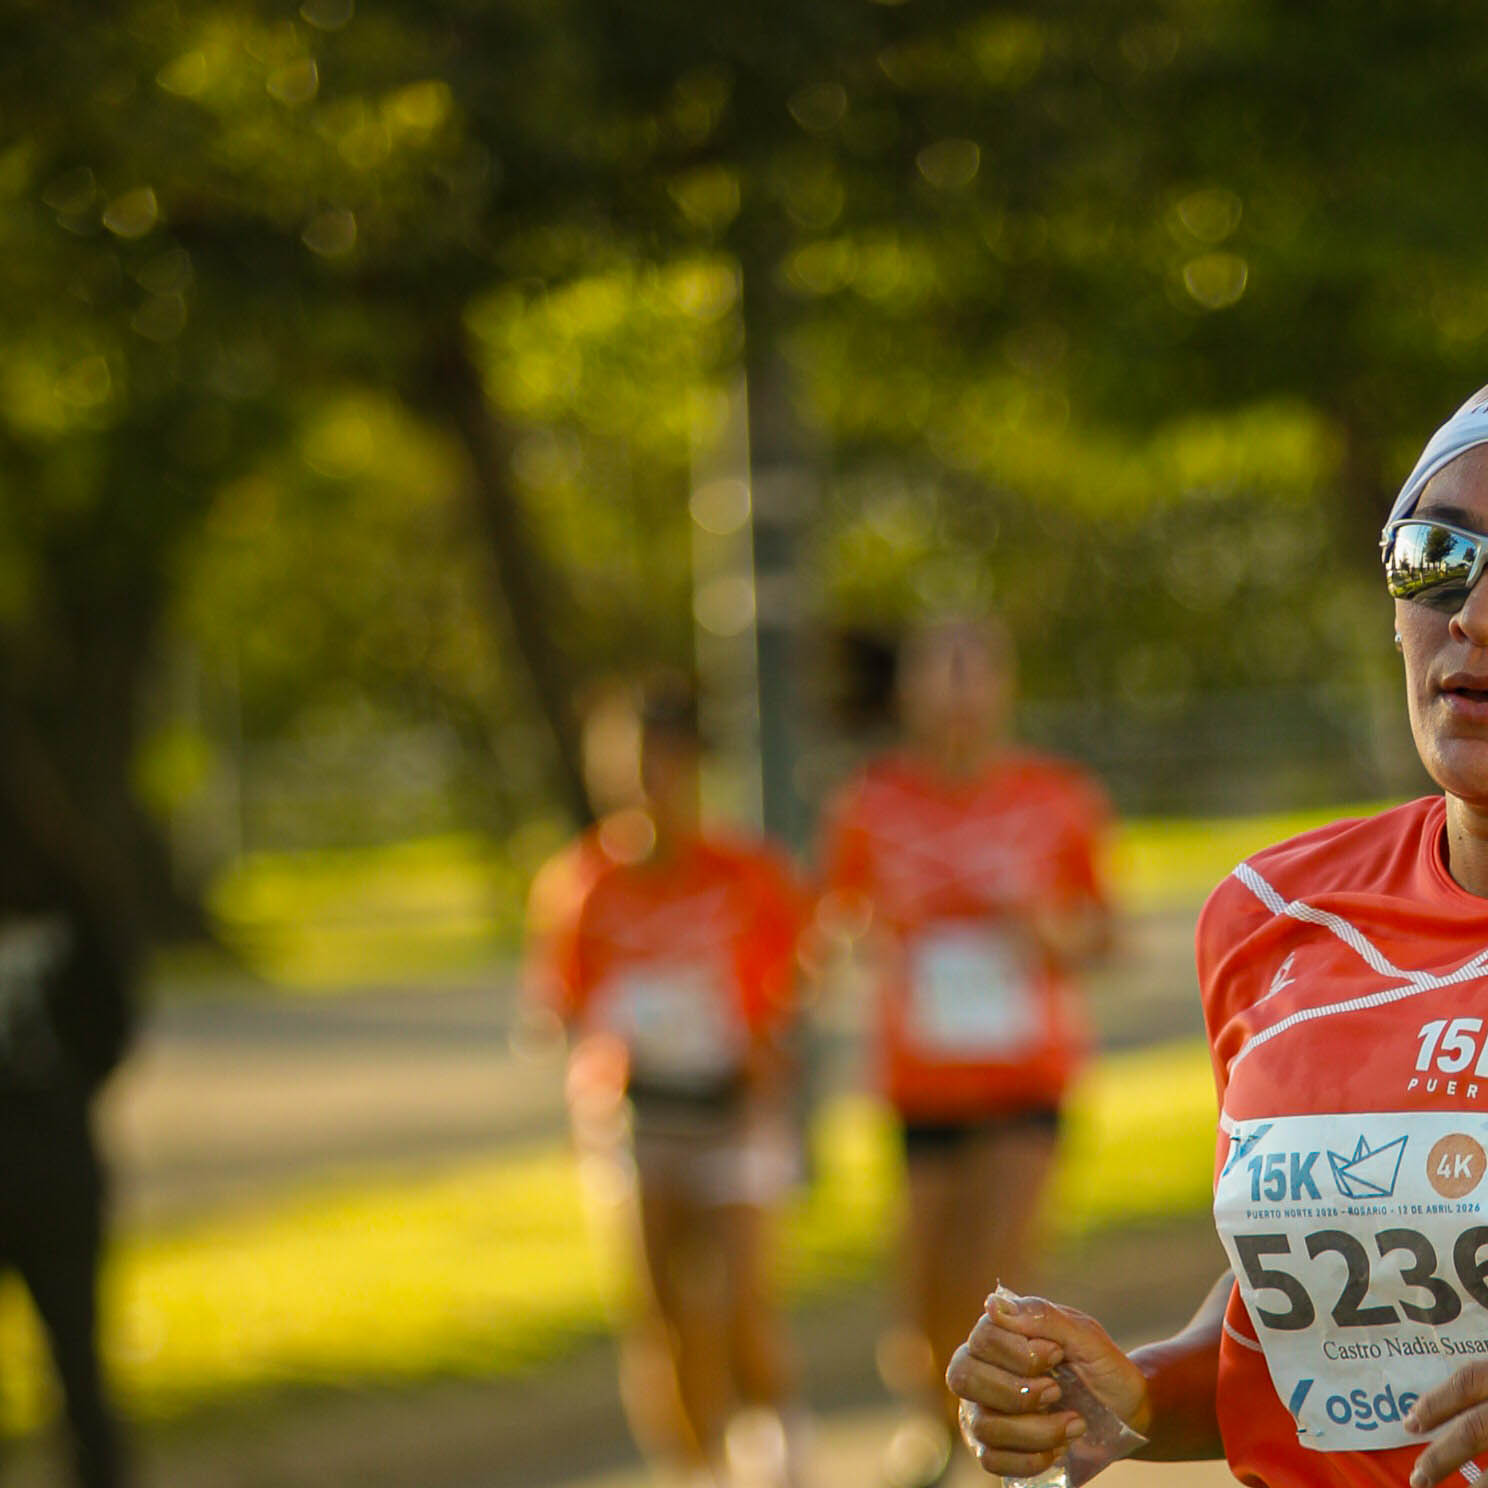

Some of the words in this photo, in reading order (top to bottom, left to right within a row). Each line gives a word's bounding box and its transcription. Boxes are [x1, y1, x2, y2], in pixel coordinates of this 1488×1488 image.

[1246, 1151, 1322, 1202] 15K
[1436, 1154, 1473, 1180] 4K
[1246, 1208, 1281, 1219] PUERTO
[1284, 1208, 1313, 1218] NORTE
[1316, 1207, 1338, 1217] 2026
[1347, 1205, 1387, 1217] ROSARIO
[1411, 1204, 1423, 1215] DE
[1426, 1203, 1453, 1215] ABRIL
[1456, 1202, 1480, 1213] 2026
[1323, 1340, 1381, 1361] Castro
[1384, 1335, 1439, 1358] Nadia
